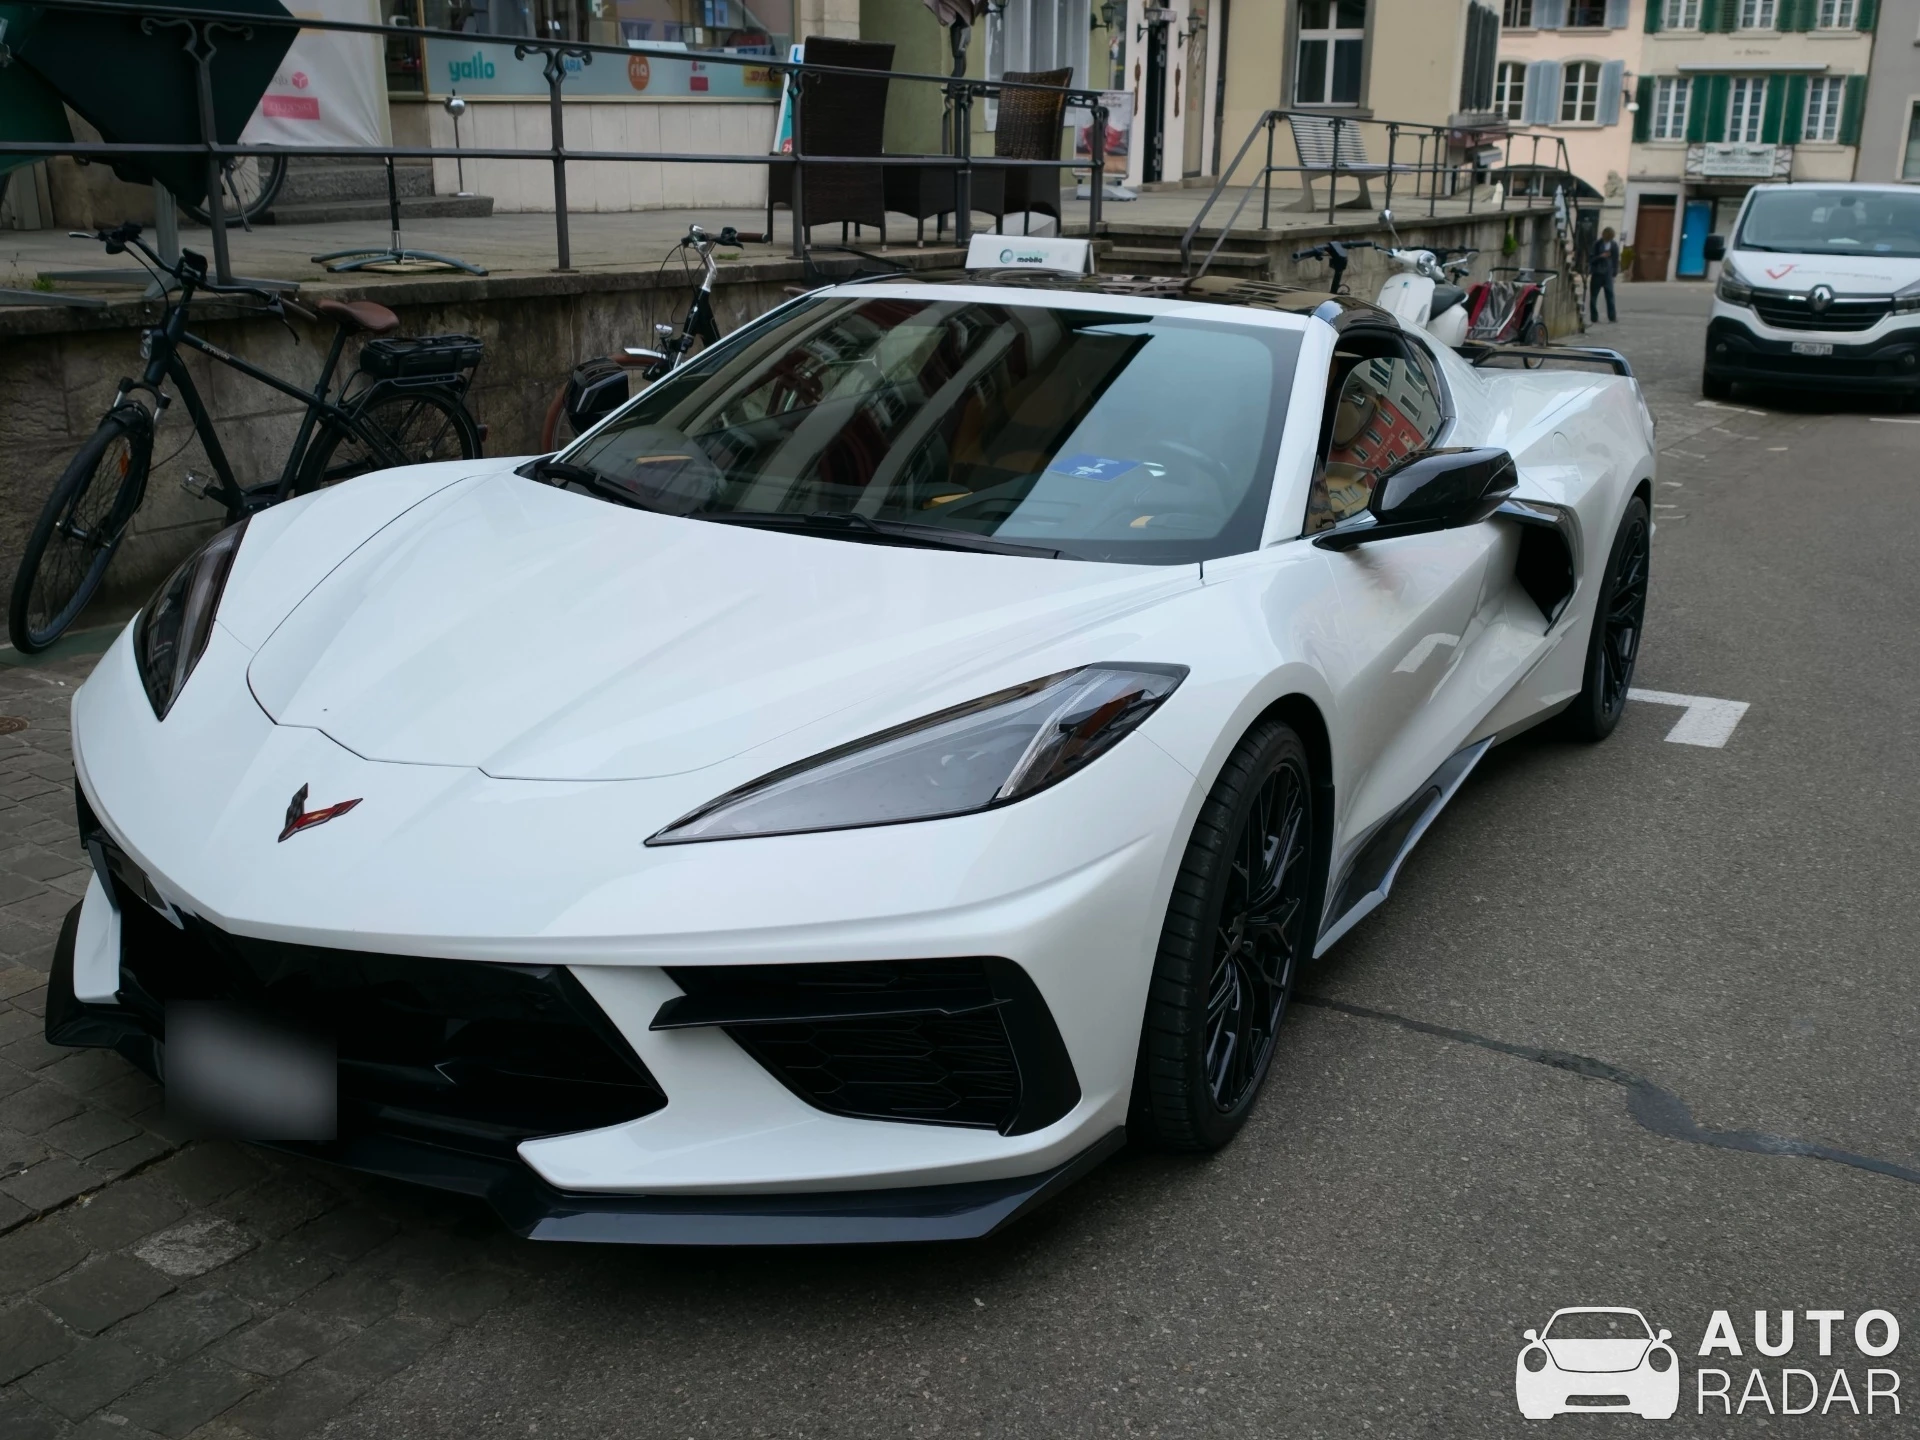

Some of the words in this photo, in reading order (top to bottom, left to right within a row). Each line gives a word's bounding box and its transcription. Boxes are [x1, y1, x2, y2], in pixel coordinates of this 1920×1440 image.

[448, 50, 495, 82] yallo
[564, 58, 582, 72] ARA
[630, 57, 647, 77] ria
